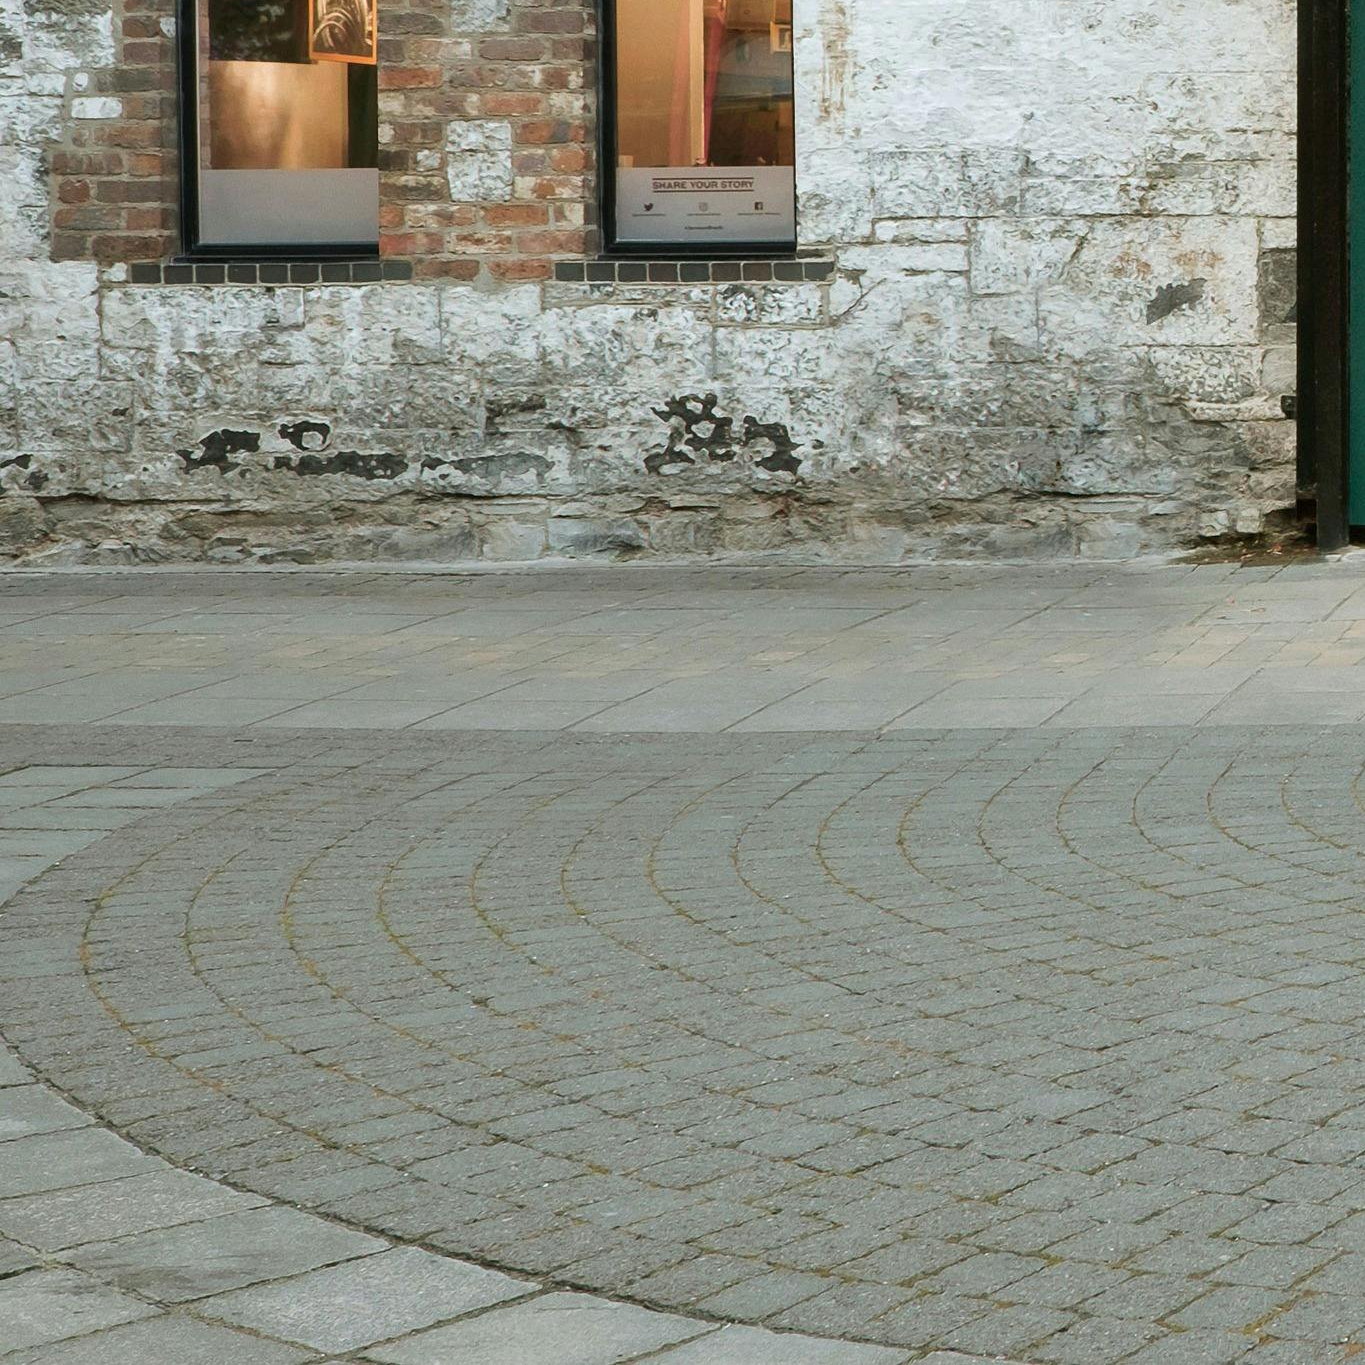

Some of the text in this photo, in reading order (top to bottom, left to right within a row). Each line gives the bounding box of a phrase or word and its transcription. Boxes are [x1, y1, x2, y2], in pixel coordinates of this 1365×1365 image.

[652, 180, 753, 189] SHARE YOUR STORY
